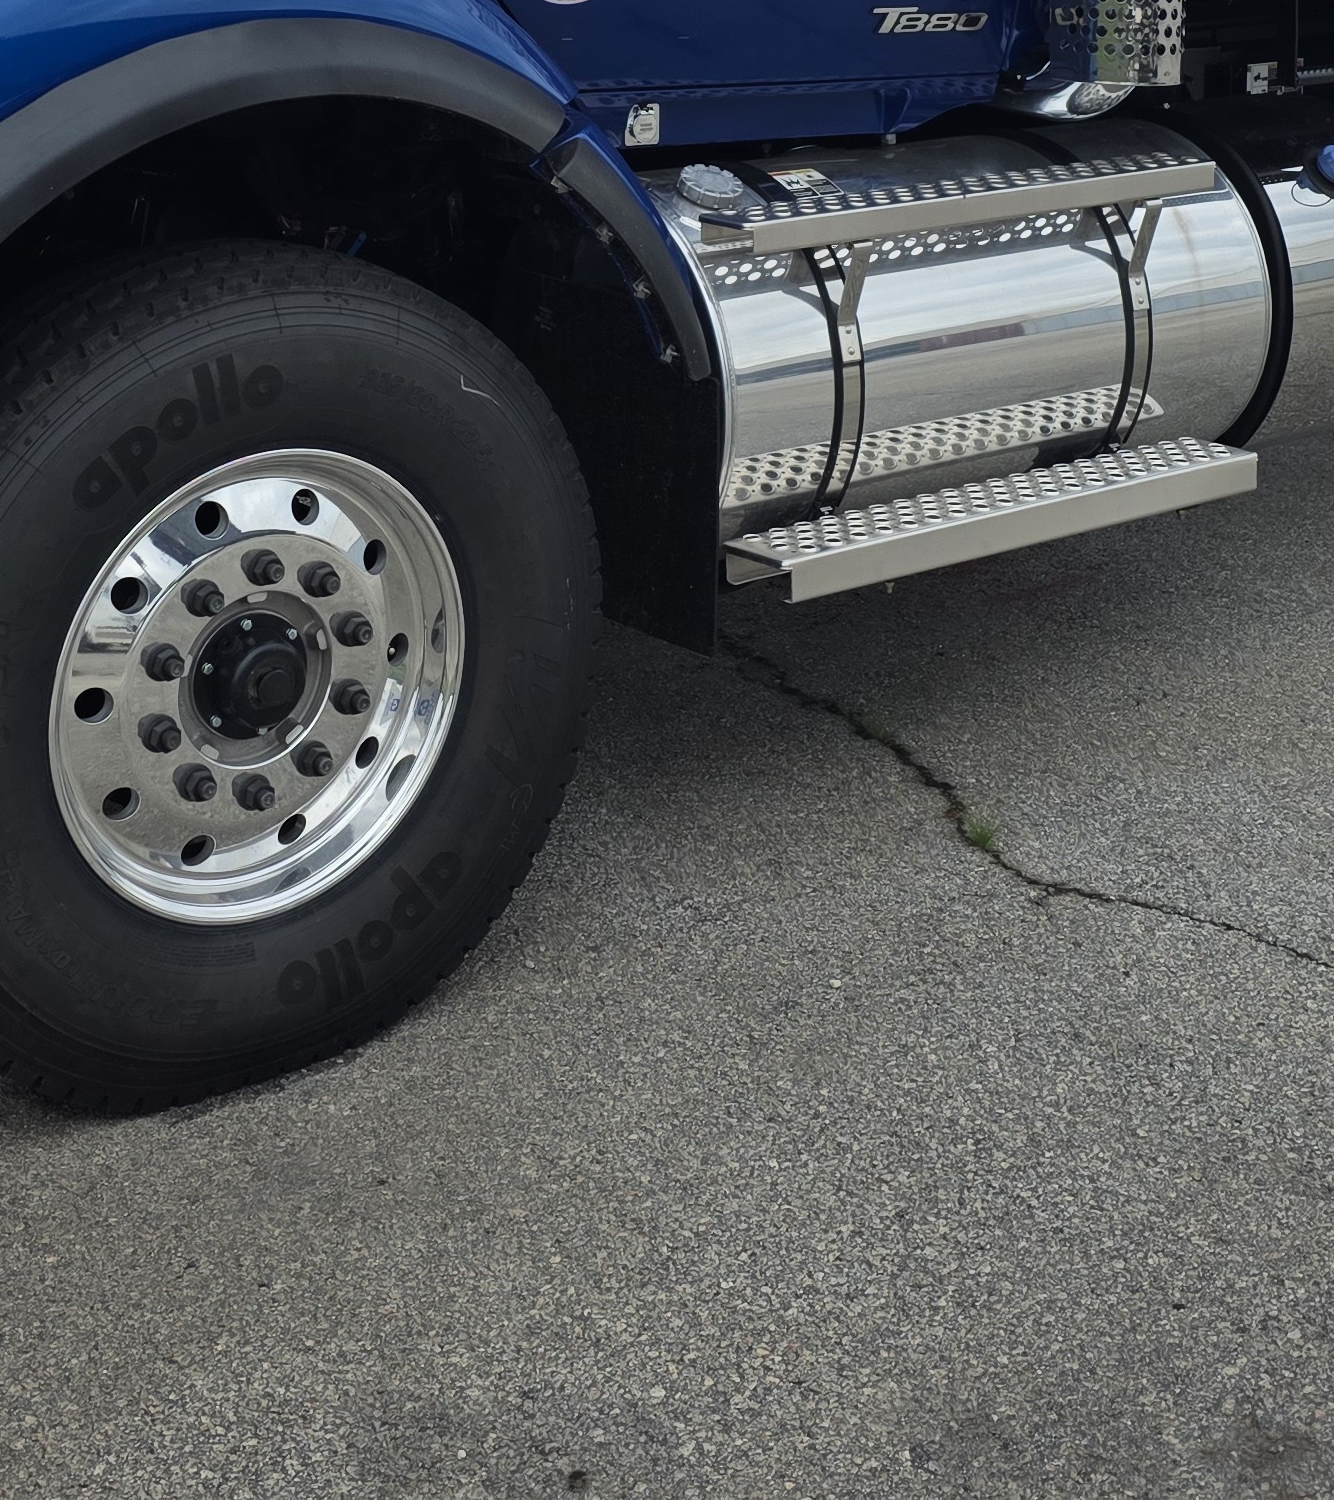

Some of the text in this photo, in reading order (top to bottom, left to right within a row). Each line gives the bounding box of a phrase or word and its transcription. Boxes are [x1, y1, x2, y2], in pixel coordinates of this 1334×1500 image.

[873, 6, 989, 34] T880
[72, 354, 284, 515] apollo
[277, 849, 463, 1005] apollo
